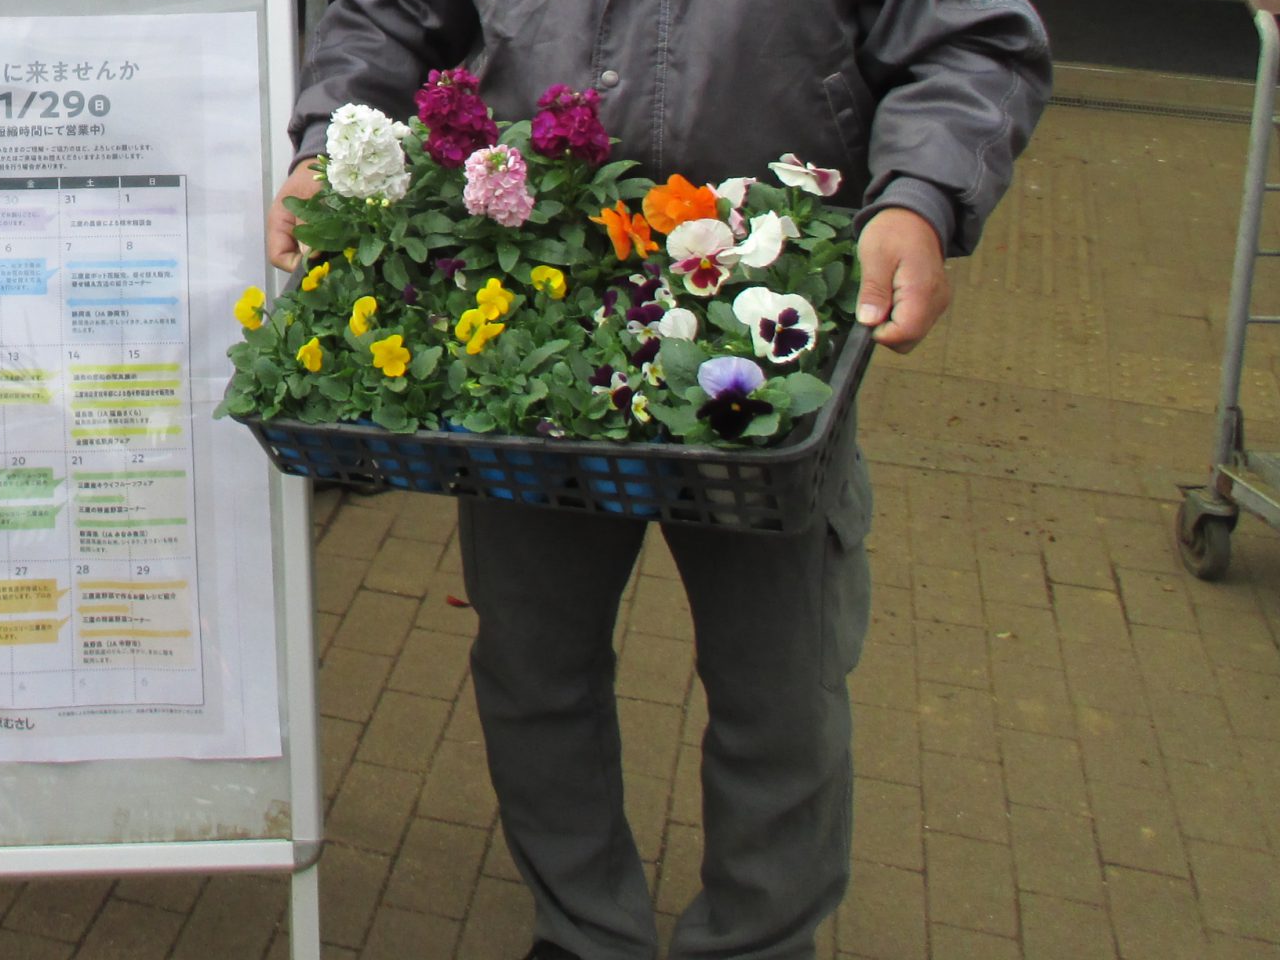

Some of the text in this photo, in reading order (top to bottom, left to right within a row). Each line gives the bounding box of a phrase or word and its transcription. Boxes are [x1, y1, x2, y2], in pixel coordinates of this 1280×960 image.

[26, 179, 35, 188] 金
[85, 179, 95, 187] 土
[149, 177, 156, 186] 日
[64, 195, 77, 204] 31
[125, 193, 131, 203] 1
[5, 243, 12, 253] 6
[66, 242, 72, 251] 7
[126, 241, 133, 250] 8
[8, 352, 19, 361] 13
[68, 351, 80, 360] 14
[129, 349, 141, 359] 15
[11, 457, 26, 466] 20
[72, 456, 83, 465] 21
[131, 454, 144, 463] 22
[15, 567, 28, 576] 27
[76, 565, 89, 574] 28
[136, 566, 150, 575] 29
